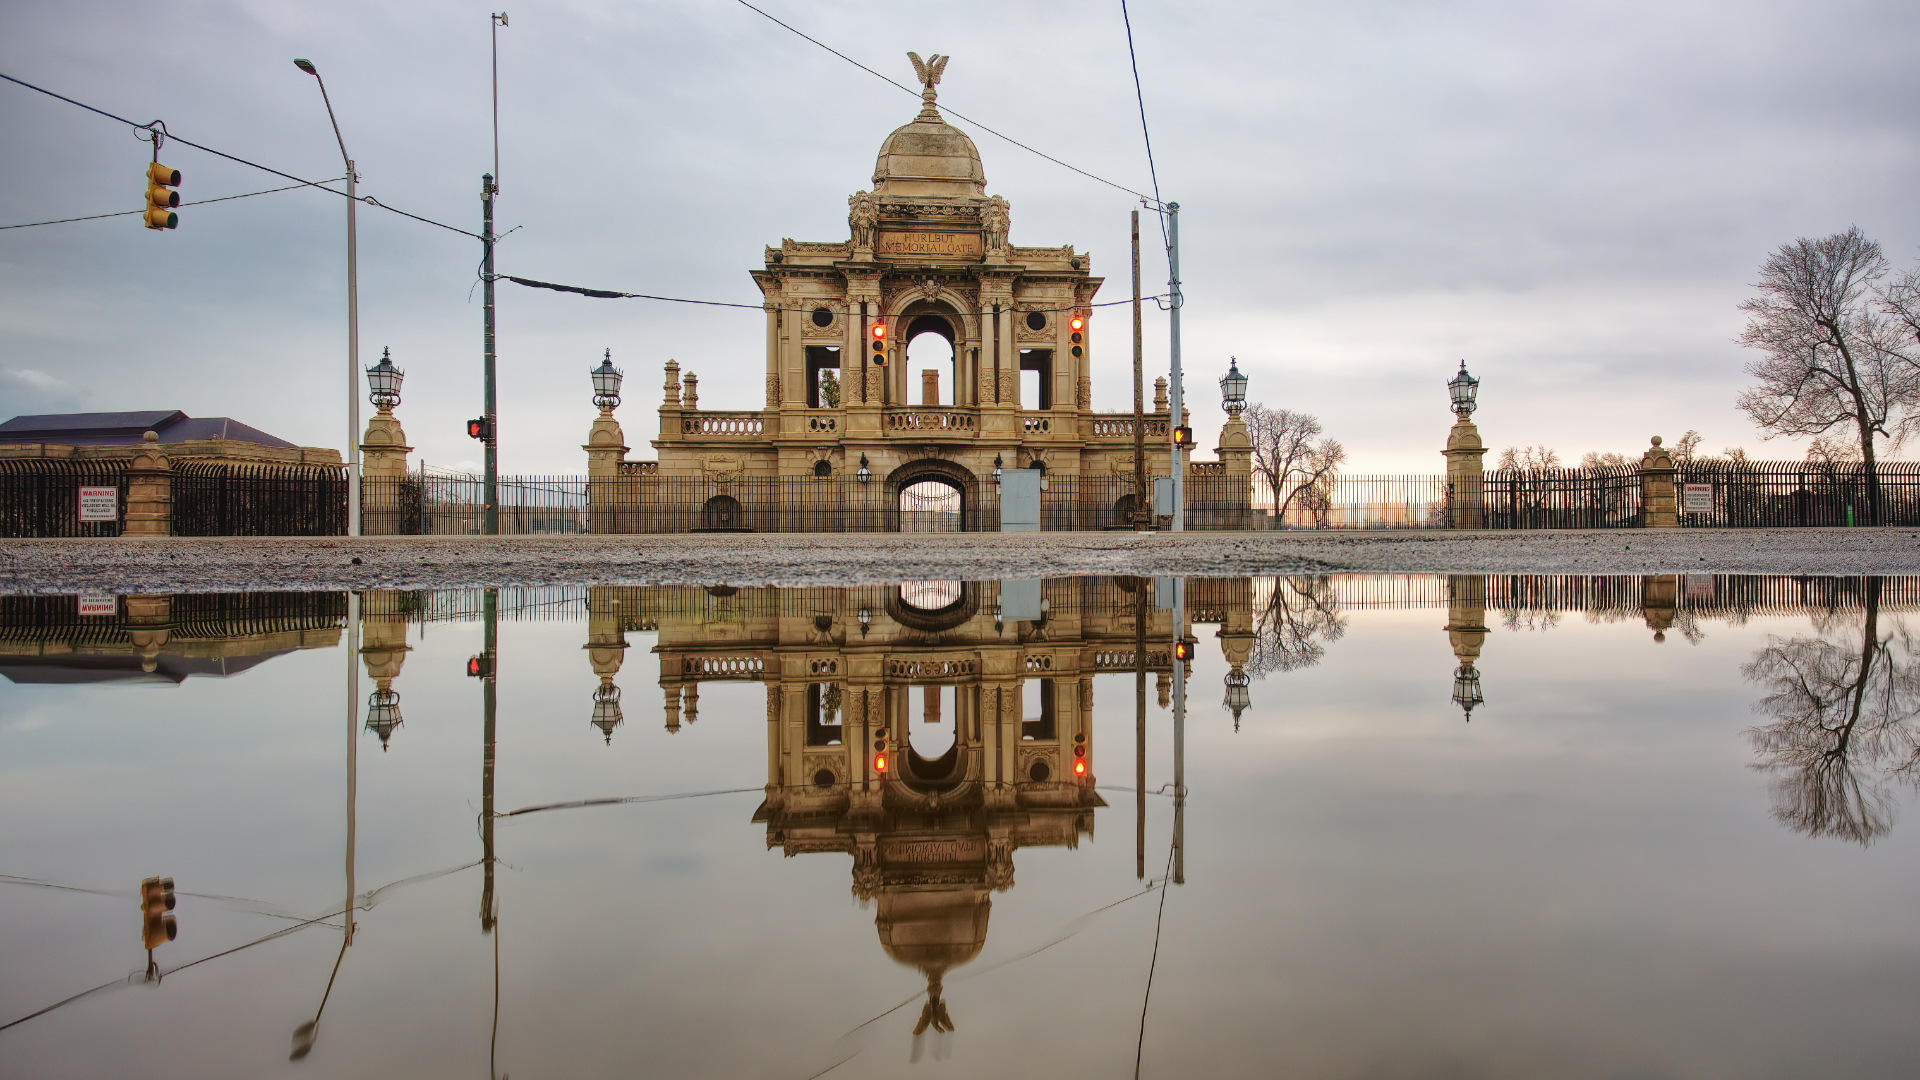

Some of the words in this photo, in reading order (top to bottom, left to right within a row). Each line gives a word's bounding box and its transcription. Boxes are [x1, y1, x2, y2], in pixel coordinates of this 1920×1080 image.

[904, 233, 956, 243] HURLBUT
[885, 242, 944, 252] MEMORIAL
[947, 243, 974, 253] GATE
